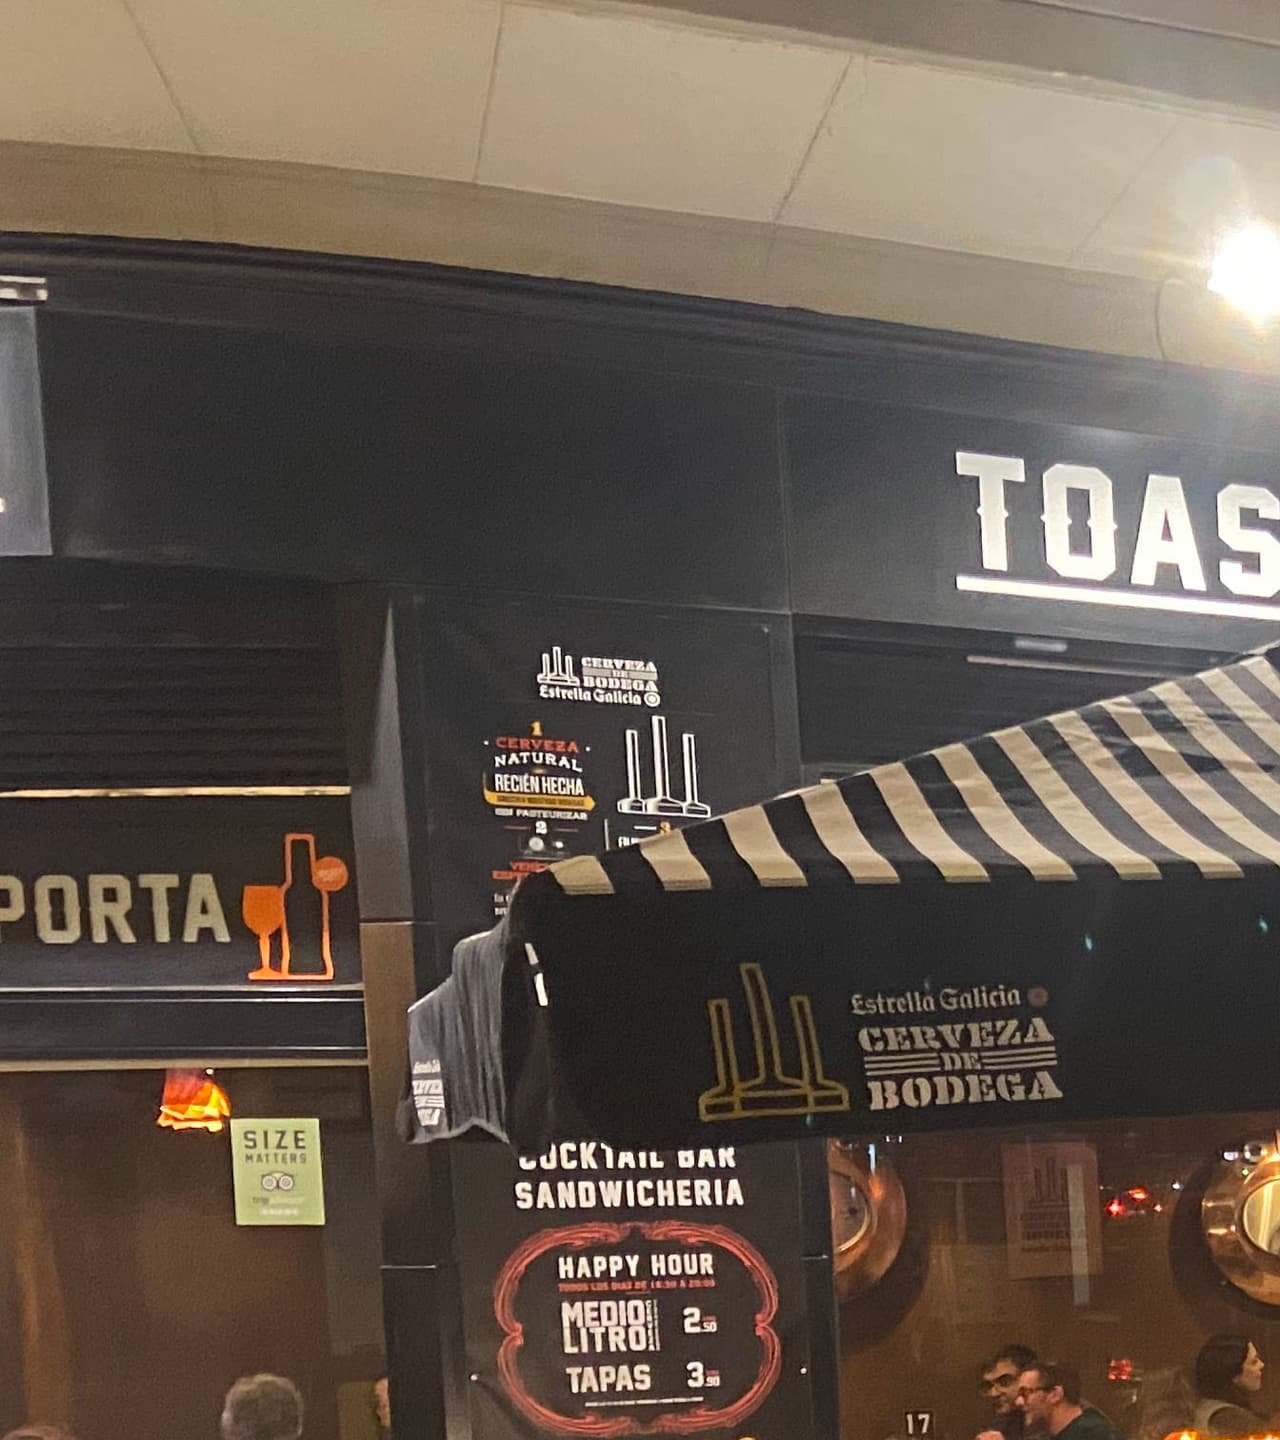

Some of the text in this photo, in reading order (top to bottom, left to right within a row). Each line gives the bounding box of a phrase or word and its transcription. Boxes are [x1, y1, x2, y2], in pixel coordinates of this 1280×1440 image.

[582, 657, 657, 672] CERVEZA
[584, 676, 658, 692] BODEGA
[540, 685, 642, 705] Estrella Galicia
[531, 721, 543, 736] 1
[495, 736, 579, 753] CERVEZA
[495, 752, 583, 772] NATURAL
[495, 773, 585, 797] RECIÉN HECHA
[535, 820, 547, 834] 2
[850, 984, 1021, 1016] Estrella Galicia
[857, 1016, 1055, 1052] CERVEZA
[941, 1051, 982, 1071] DE
[867, 1071, 1064, 1111] BODEGA
[243, 1130, 306, 1150] SIZE
[245, 1153, 307, 1164] MATTERS
[677, 1146, 736, 1168] BAR
[515, 1178, 745, 1209] SANDWICHERIA
[558, 1253, 714, 1279] HAPPY HOUR
[561, 1299, 646, 1329] MEDIO
[563, 1325, 647, 1354] LITRO
[566, 1364, 651, 1393] TAPAS
[906, 1413, 930, 1434] 17
